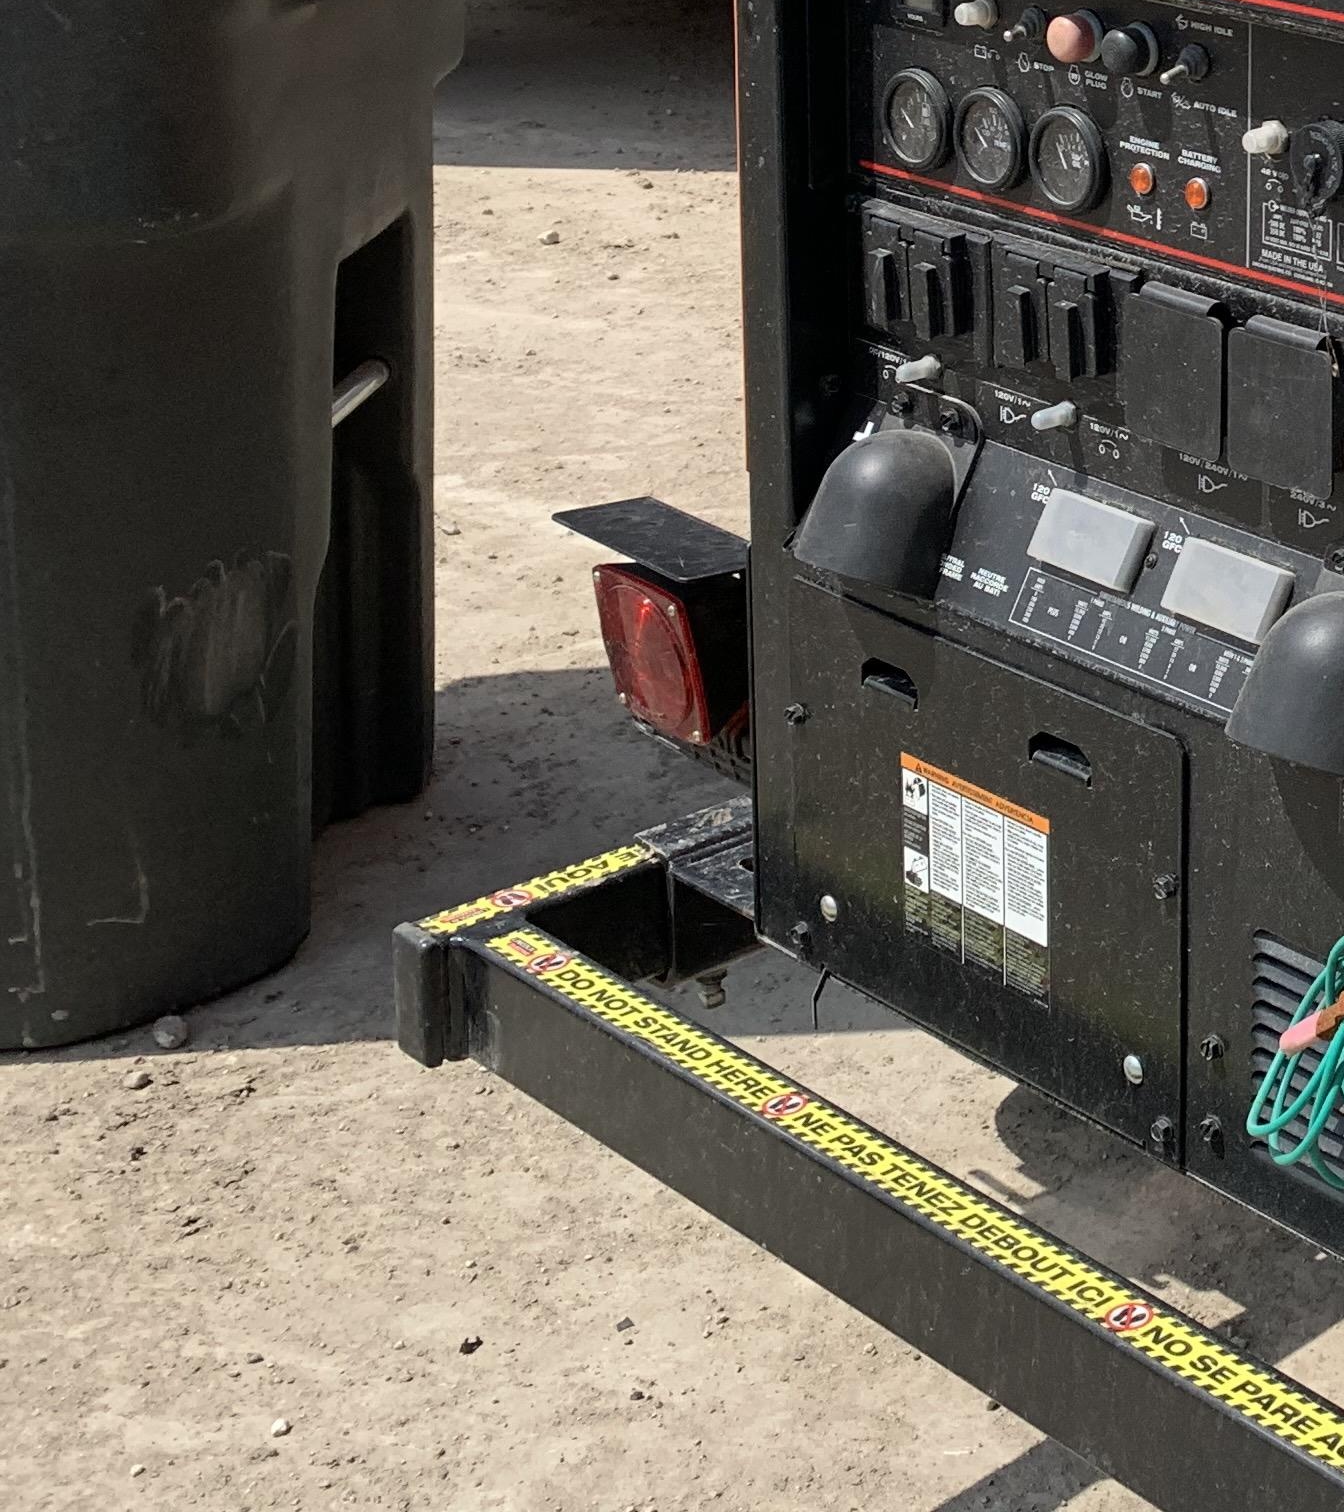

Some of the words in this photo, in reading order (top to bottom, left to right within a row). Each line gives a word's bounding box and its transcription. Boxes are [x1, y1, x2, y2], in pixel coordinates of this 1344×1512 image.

[1190, 21, 1212, 34] HIGH
[1212, 24, 1234, 37] IDLE
[1033, 61, 1056, 73] STOP
[1084, 69, 1109, 82] GLOW
[1085, 77, 1107, 90] PLUG
[1137, 86, 1163, 100] START
[1193, 101, 1217, 114] AUTO
[1217, 105, 1238, 119] IDLE
[1119, 141, 1170, 162] PROTECTION
[1129, 135, 1161, 151] ENGINE
[1177, 156, 1222, 174] CHARGING
[1181, 149, 1219, 165] BATTERY
[1261, 248, 1282, 262] MADE
[1283, 255, 1292, 265] IN
[1292, 257, 1308, 269] THE
[1308, 261, 1325, 274] USA
[555, 969, 595, 991] DO
[591, 988, 644, 1018] NOT
[633, 1015, 714, 1062] STAND
[704, 1059, 778, 1101] HERE
[795, 1110, 837, 1136] NE
[834, 1132, 886, 1169] PAS
[879, 1163, 969, 1218] TENEZ
[958, 1213, 1076, 1283] DEBOUT
[1068, 1279, 1114, 1307] ICI
[1143, 1325, 1194, 1359] NO
[1188, 1354, 1240, 1385] SE
[1231, 1379, 1323, 1437] PARE
